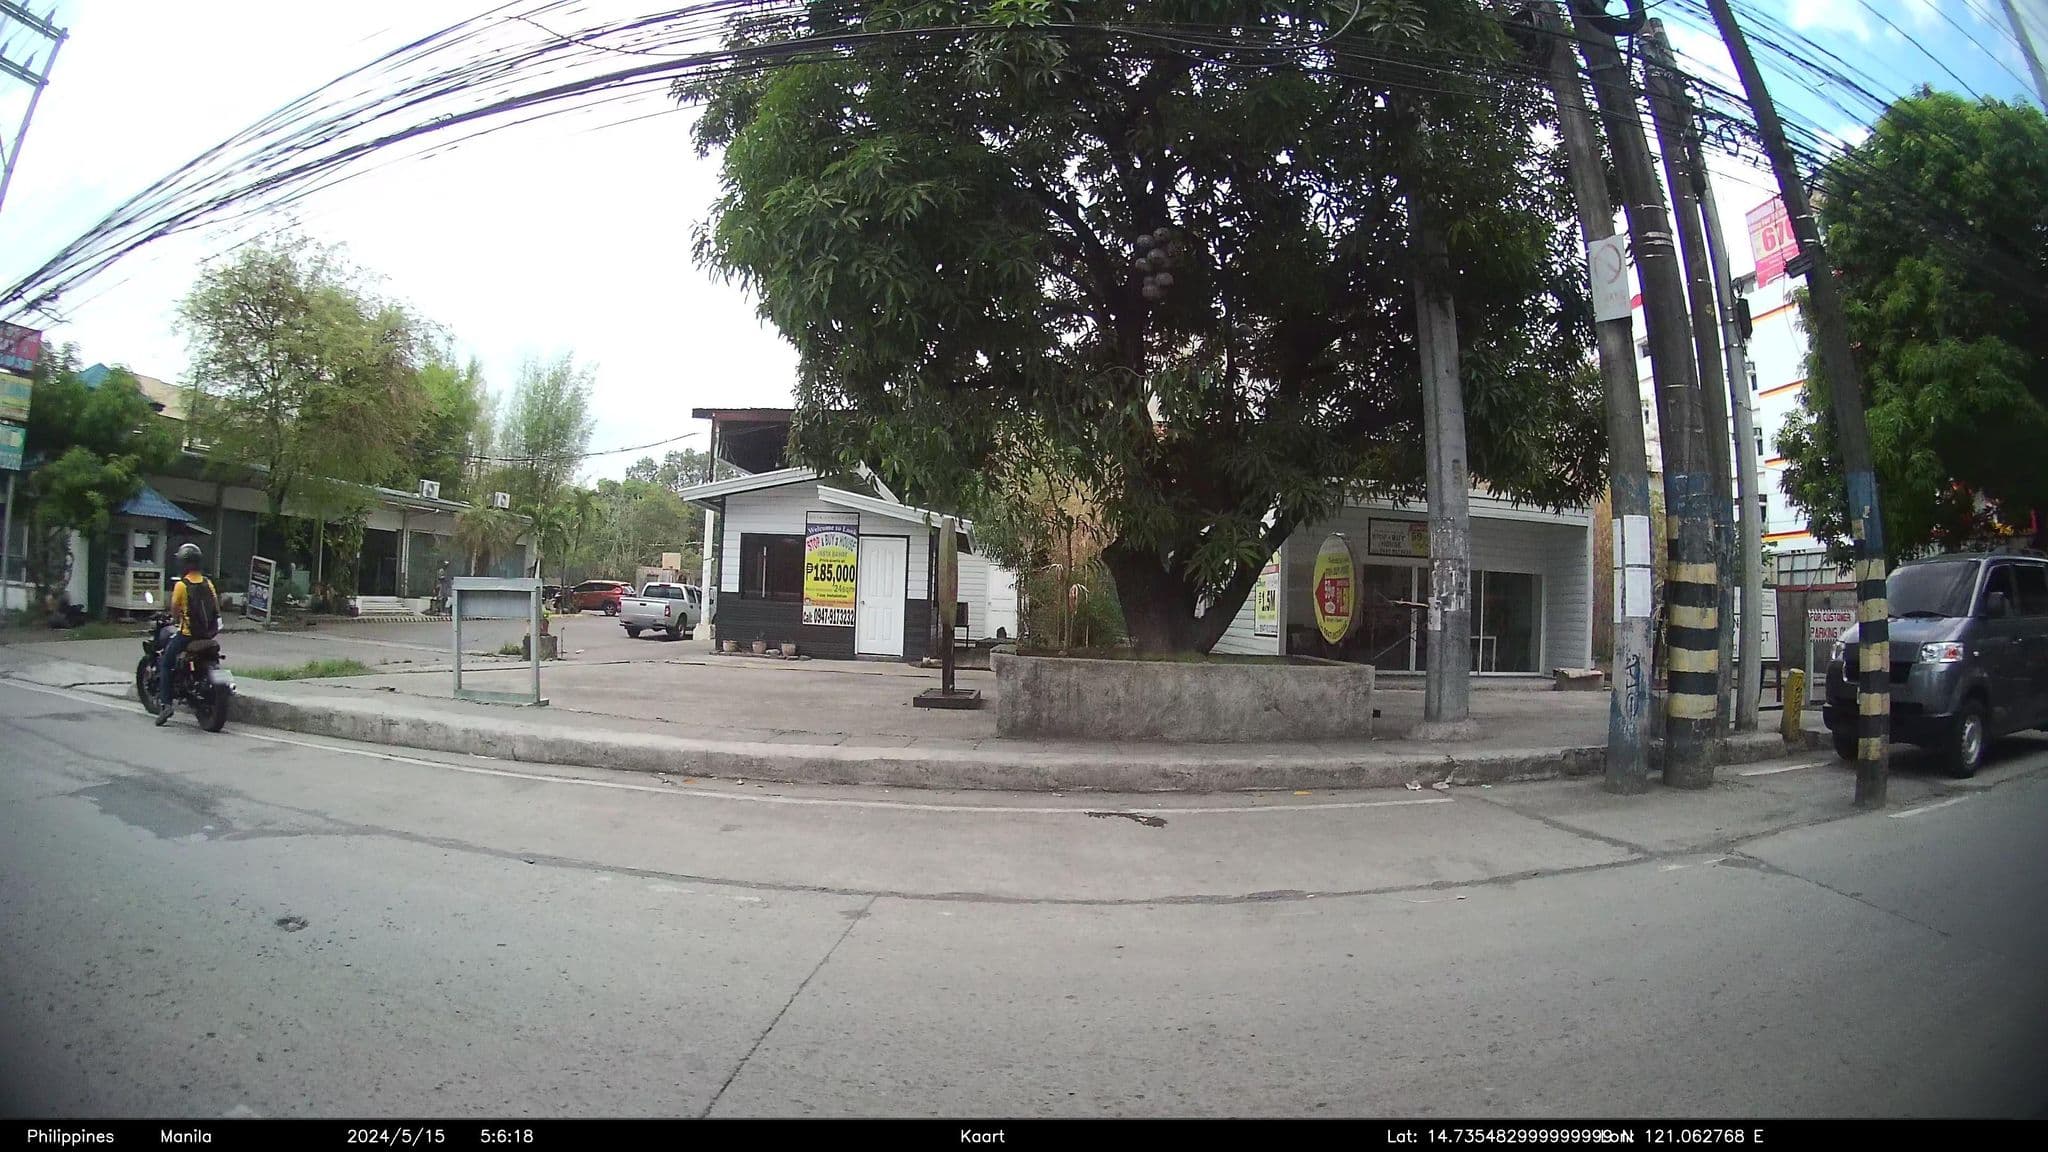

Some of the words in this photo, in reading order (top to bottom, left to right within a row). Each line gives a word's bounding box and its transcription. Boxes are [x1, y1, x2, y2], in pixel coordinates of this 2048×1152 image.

[808, 525, 835, 535] Welcome
[807, 536, 820, 551] STOP
[825, 534, 835, 546] BUY
[840, 536, 857, 552] HOUSE
[1810, 612, 1822, 622] FOR
[1823, 612, 1851, 622] CUSTOMER
[1810, 627, 1838, 639] PARKING
